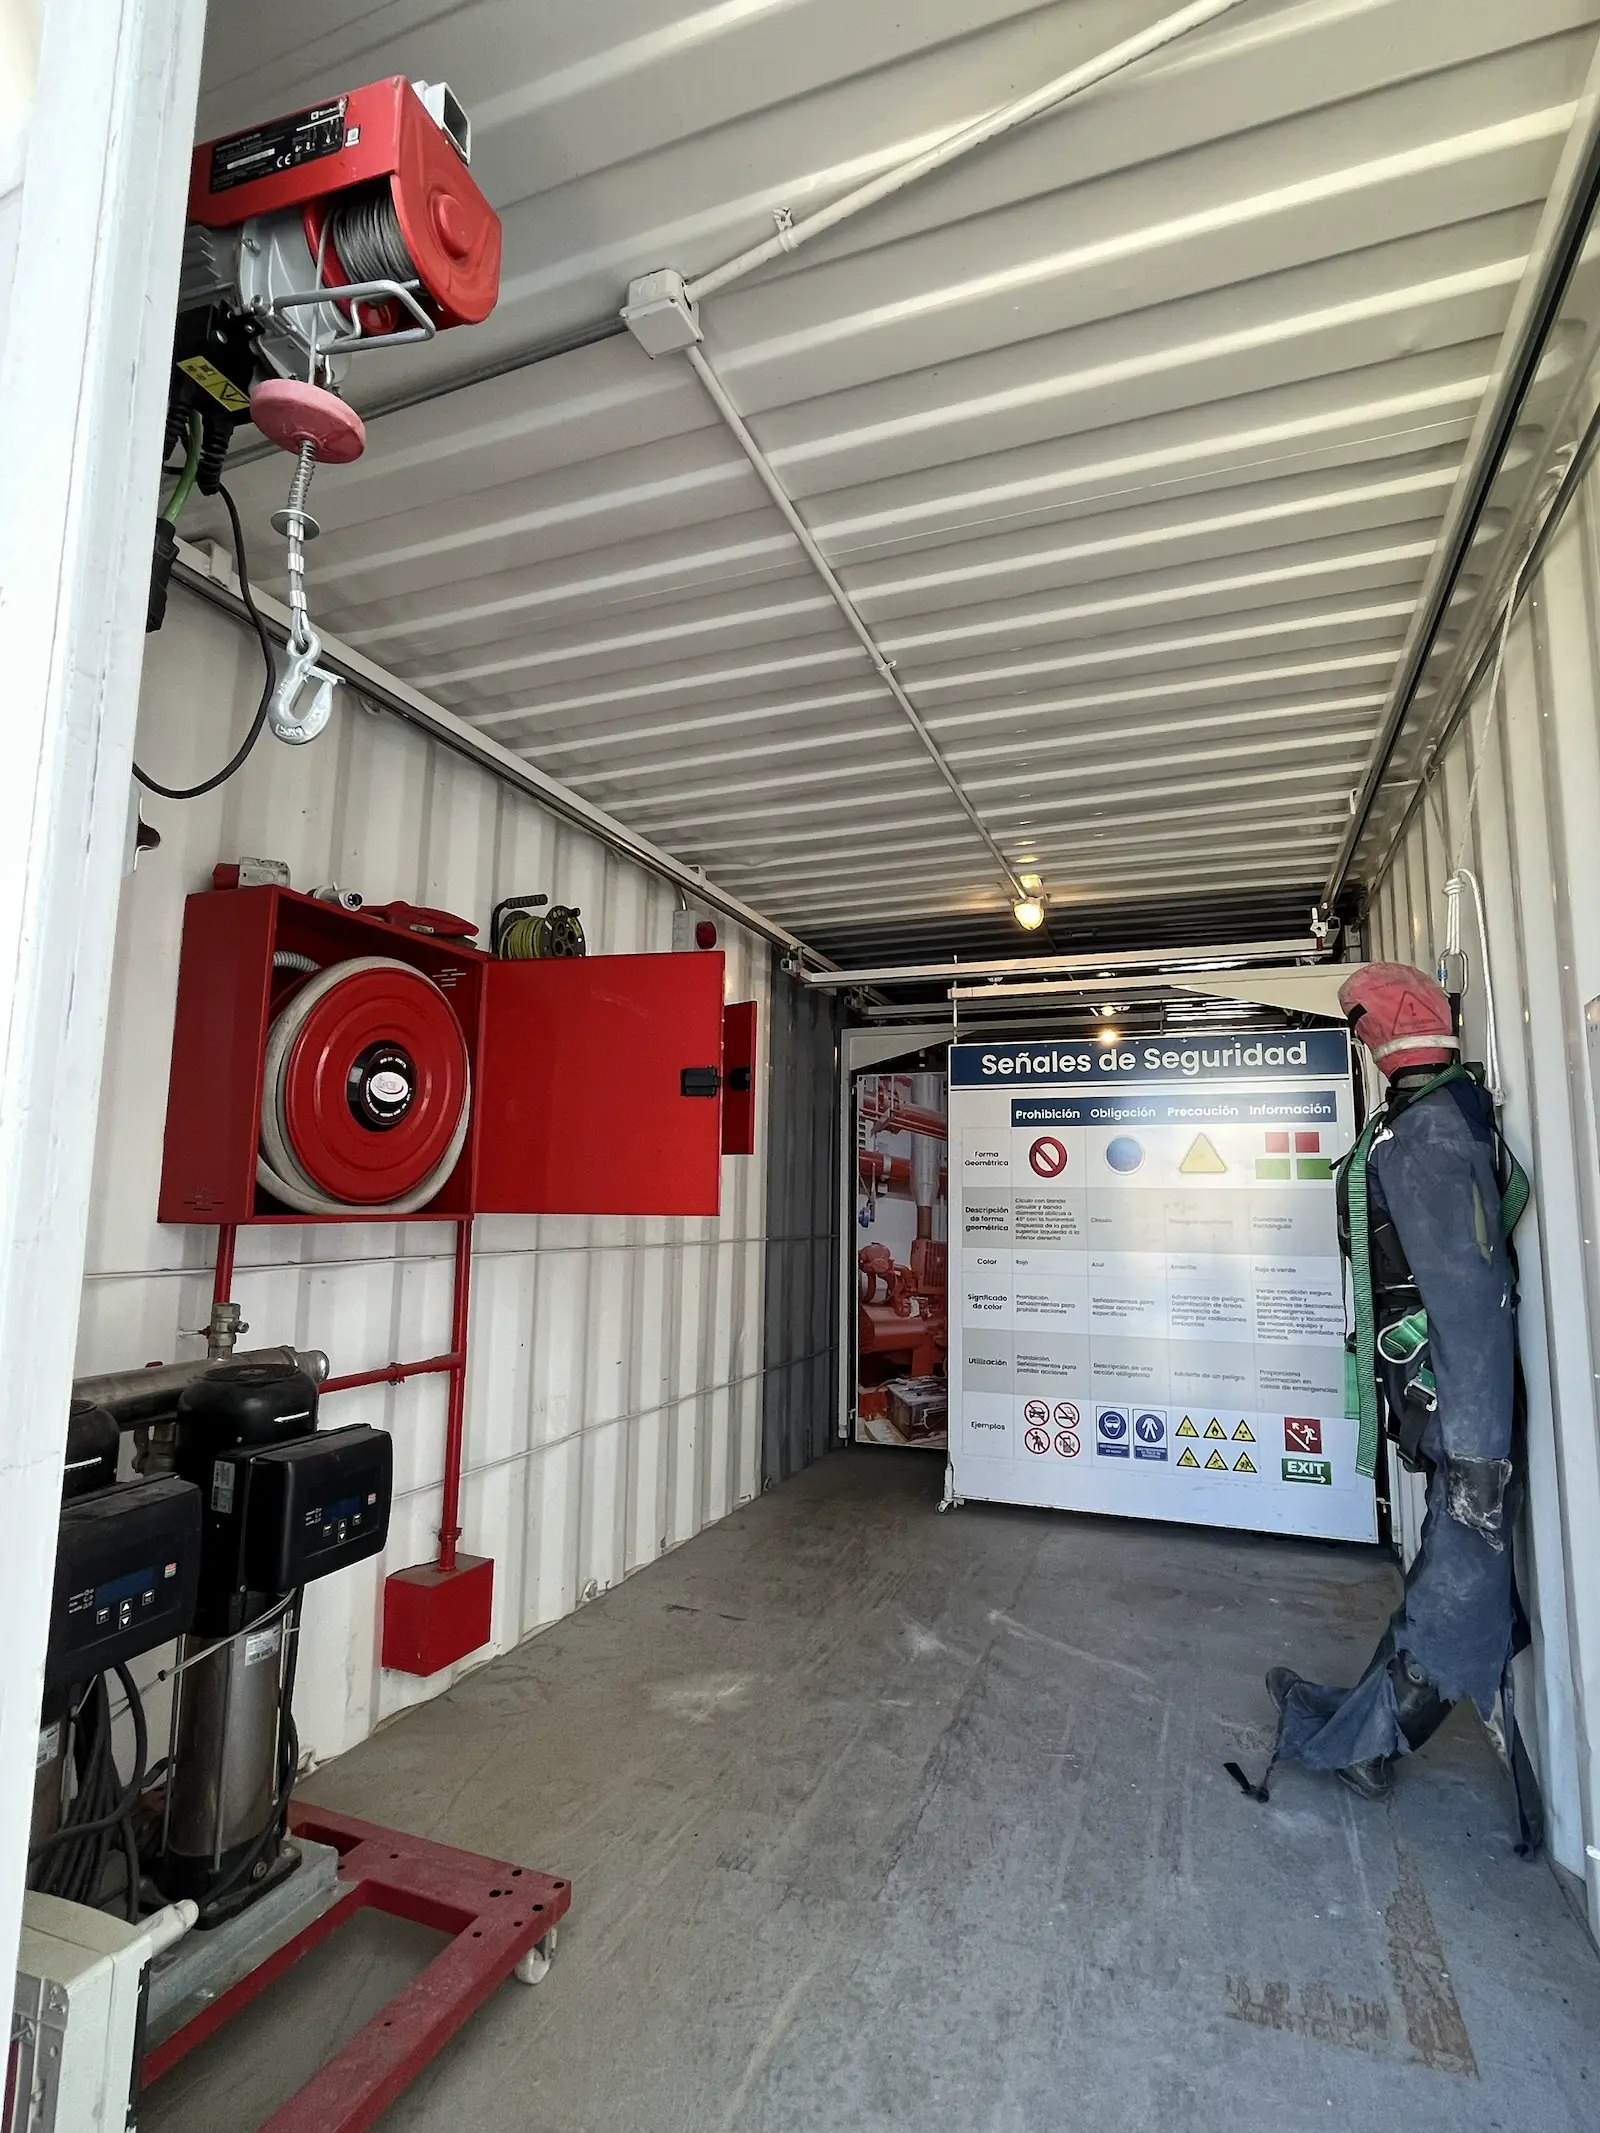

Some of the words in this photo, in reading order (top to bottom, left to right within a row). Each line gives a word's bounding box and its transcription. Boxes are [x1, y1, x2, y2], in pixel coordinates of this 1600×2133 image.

[981, 1050, 1092, 1076] Señales
[1098, 1048, 1136, 1071] de
[1144, 1041, 1307, 1075] Seguridad
[1015, 1109, 1081, 1120] Prohibición
[1090, 1107, 1157, 1120] Obligación
[1166, 1104, 1240, 1117] Precaución
[1249, 1103, 1332, 1116] Información
[965, 1206, 1009, 1214] Descripción
[968, 1358, 1007, 1366] Utilización
[971, 1421, 1006, 1431] Ejemplos
[1288, 1461, 1324, 1475] EXIT
